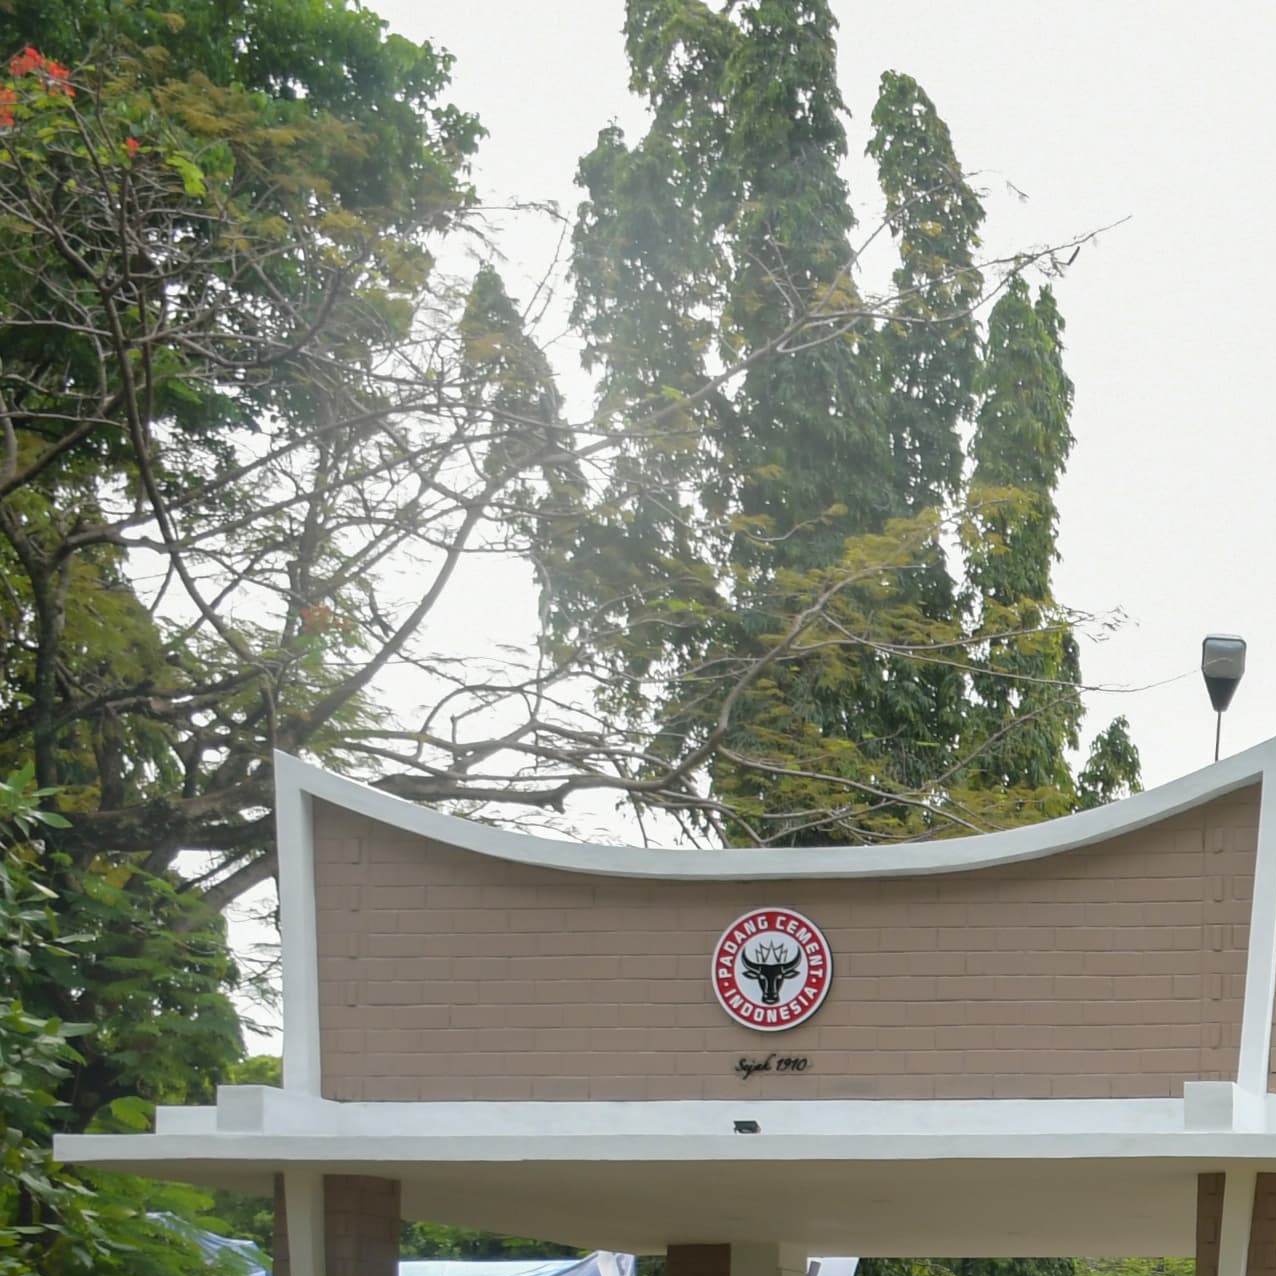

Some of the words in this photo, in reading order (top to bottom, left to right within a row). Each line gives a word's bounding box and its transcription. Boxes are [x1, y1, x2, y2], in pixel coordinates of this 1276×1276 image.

[718, 916, 769, 979] PADANG
[775, 916, 824, 978] CEMENT
[723, 986, 818, 1023] INDONESIA
[776, 1058, 808, 1071] 1910
